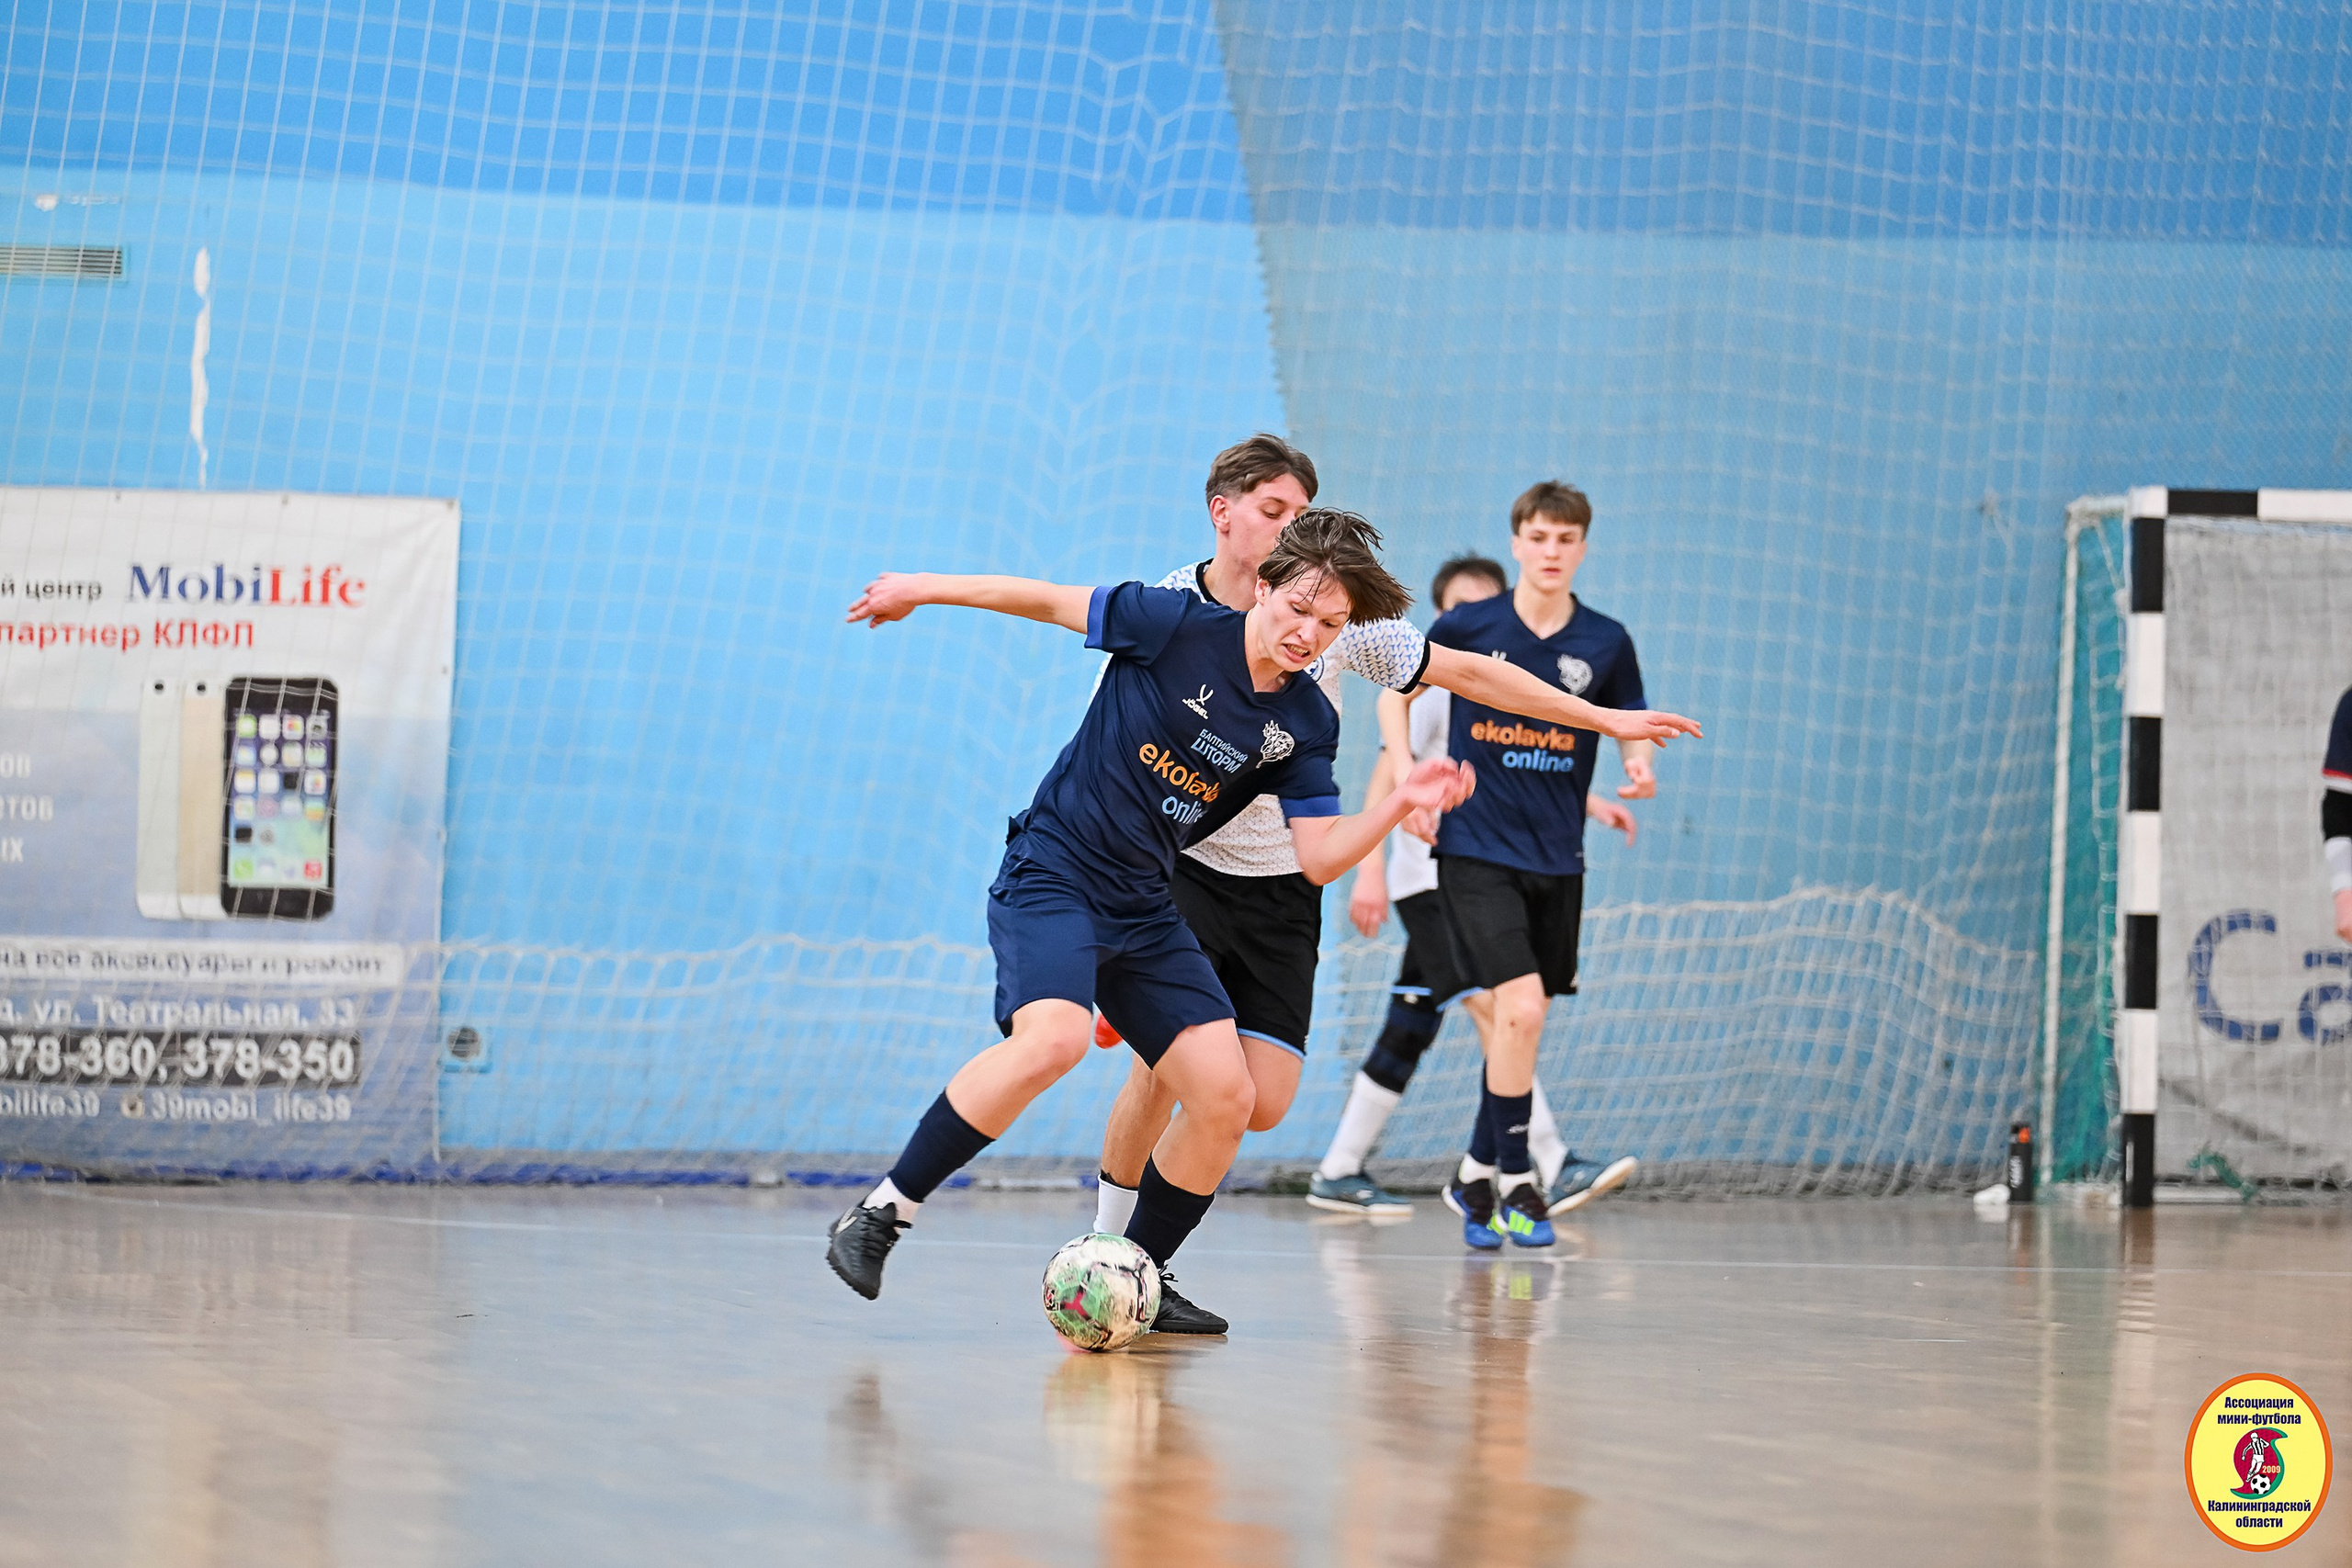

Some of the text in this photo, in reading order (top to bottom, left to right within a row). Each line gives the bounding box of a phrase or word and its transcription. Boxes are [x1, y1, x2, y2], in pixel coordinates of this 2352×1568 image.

[25, 580, 102, 604] центр
[125, 563, 366, 608] MobiLife
[0, 621, 141, 653] партнер
[1199, 728, 1249, 763] БАЛТИЙСКИЙ
[1471, 719, 1576, 751] ekolavka
[1190, 737, 1242, 773] ШТОРМ
[1502, 749, 1575, 773] online
[184, 1038, 356, 1080] 378-350
